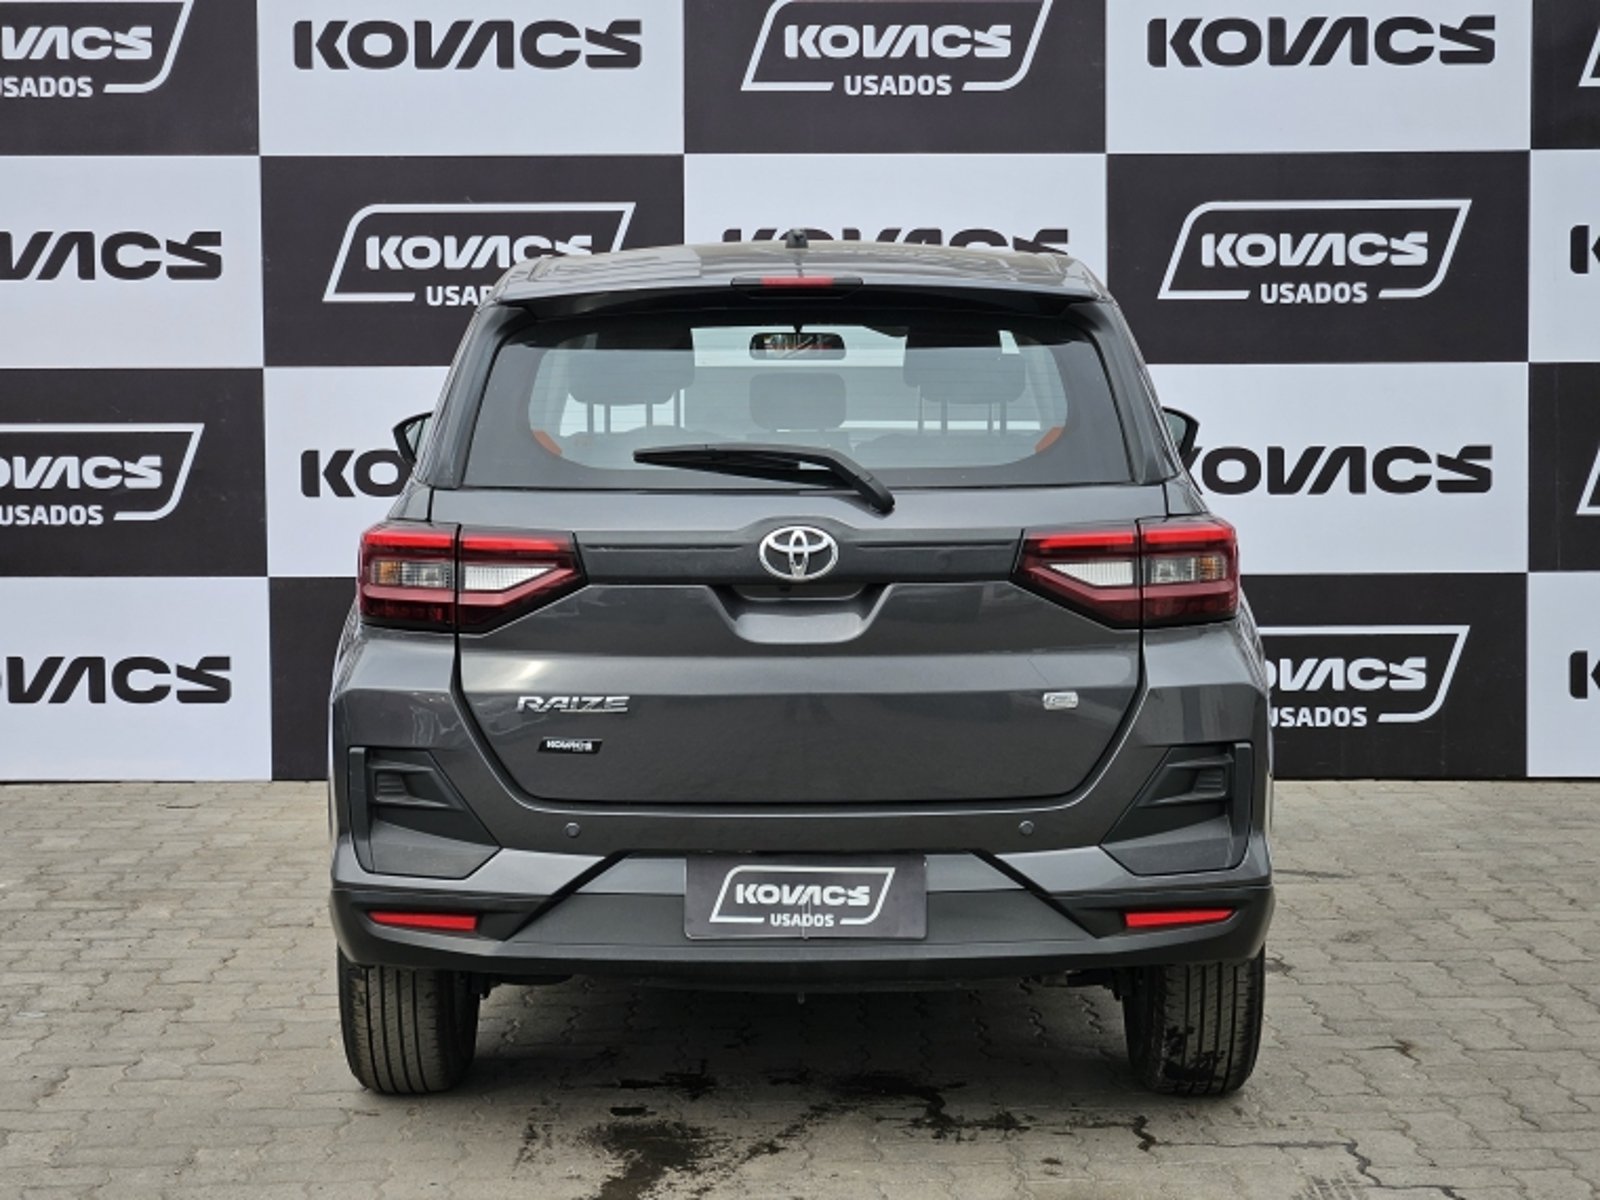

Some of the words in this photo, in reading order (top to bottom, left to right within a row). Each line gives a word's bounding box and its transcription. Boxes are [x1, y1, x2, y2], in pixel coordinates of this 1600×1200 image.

[1, 26, 152, 60] VACS
[293, 20, 642, 69] KOVACS
[784, 24, 1012, 58] KOVACS
[1147, 16, 1495, 67] KOVACS
[0, 76, 94, 98] SADOS
[843, 75, 953, 96] USADOS
[0, 231, 222, 280] VACS
[1201, 231, 1428, 267] KOVACS
[1260, 282, 1368, 304] USADOS
[0, 455, 162, 489] VACS
[0, 656, 231, 704] VACS
[516, 695, 630, 712] RAIZE
[735, 883, 871, 906] KOVACS
[769, 913, 835, 928] USADOS
